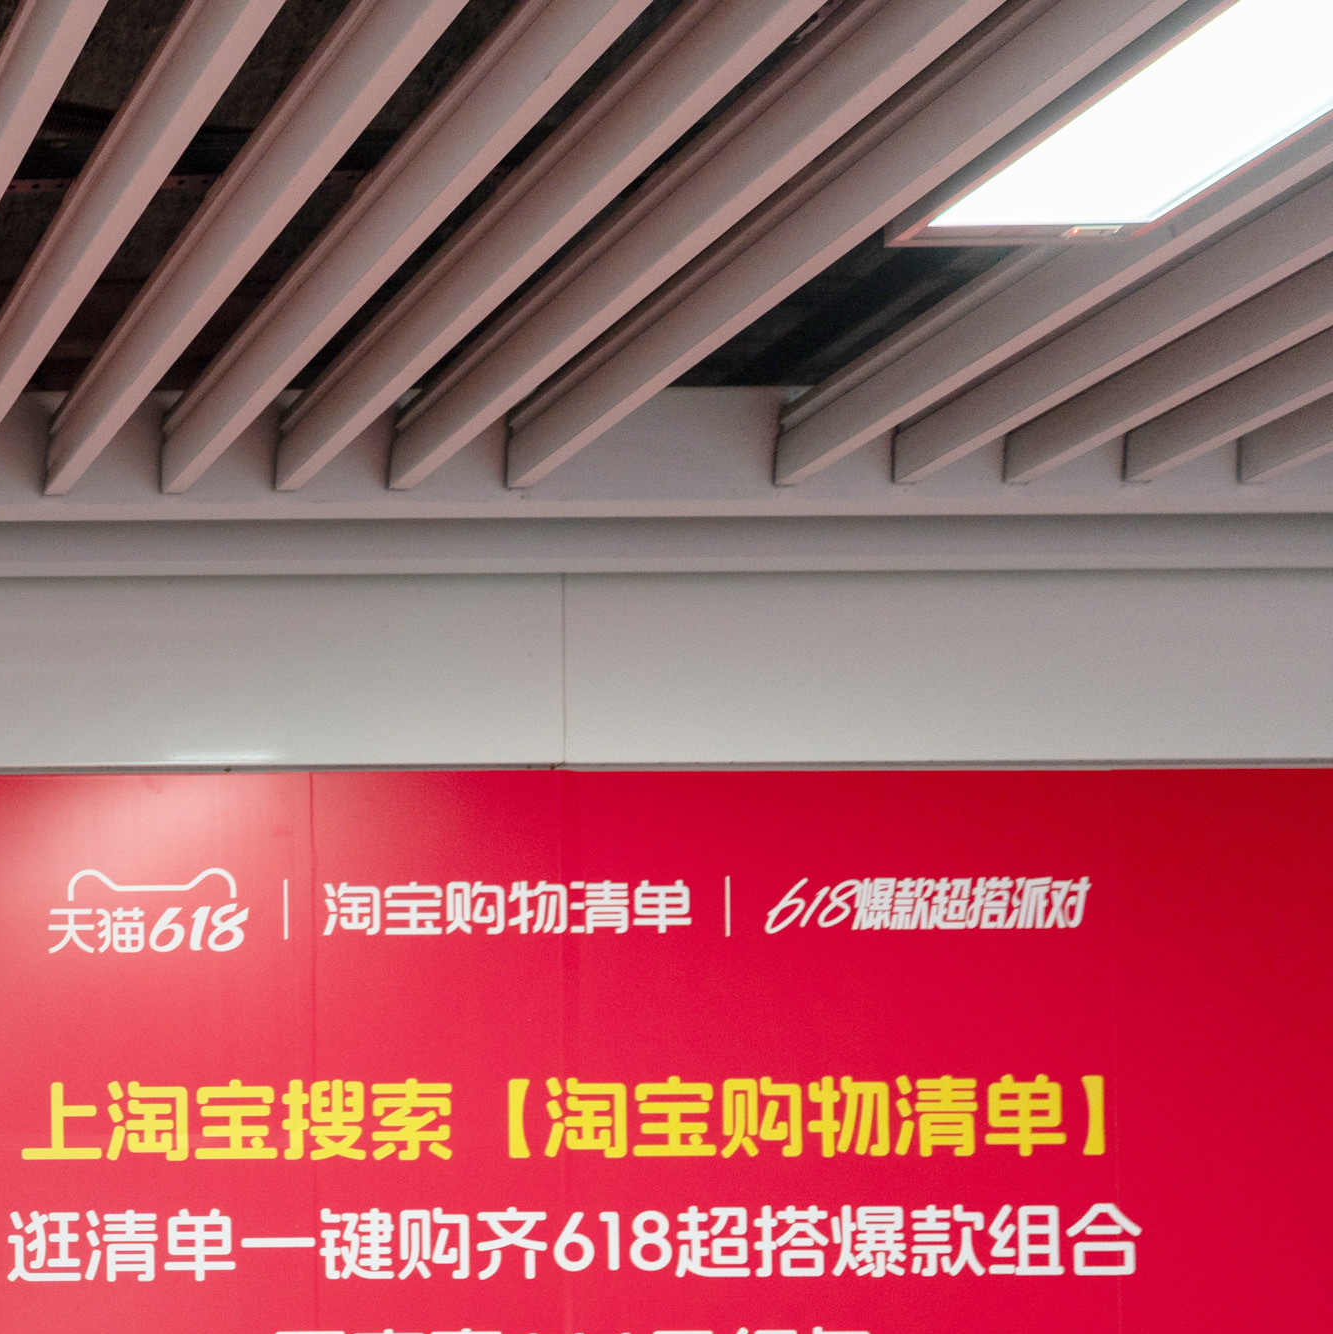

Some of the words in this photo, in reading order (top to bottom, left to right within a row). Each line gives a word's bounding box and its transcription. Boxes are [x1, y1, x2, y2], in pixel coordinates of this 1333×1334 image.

[47, 902, 250, 954] 天猫618
[323, 880, 691, 936] 淘宝购物清单
[765, 876, 1092, 934] 618爆款超搭派对
[22, 1075, 1105, 1161] 上淘宝搜索【淘宝购物清单】
[7, 1203, 1141, 1282] 逛清单一键购齐618超搭爆款组合
